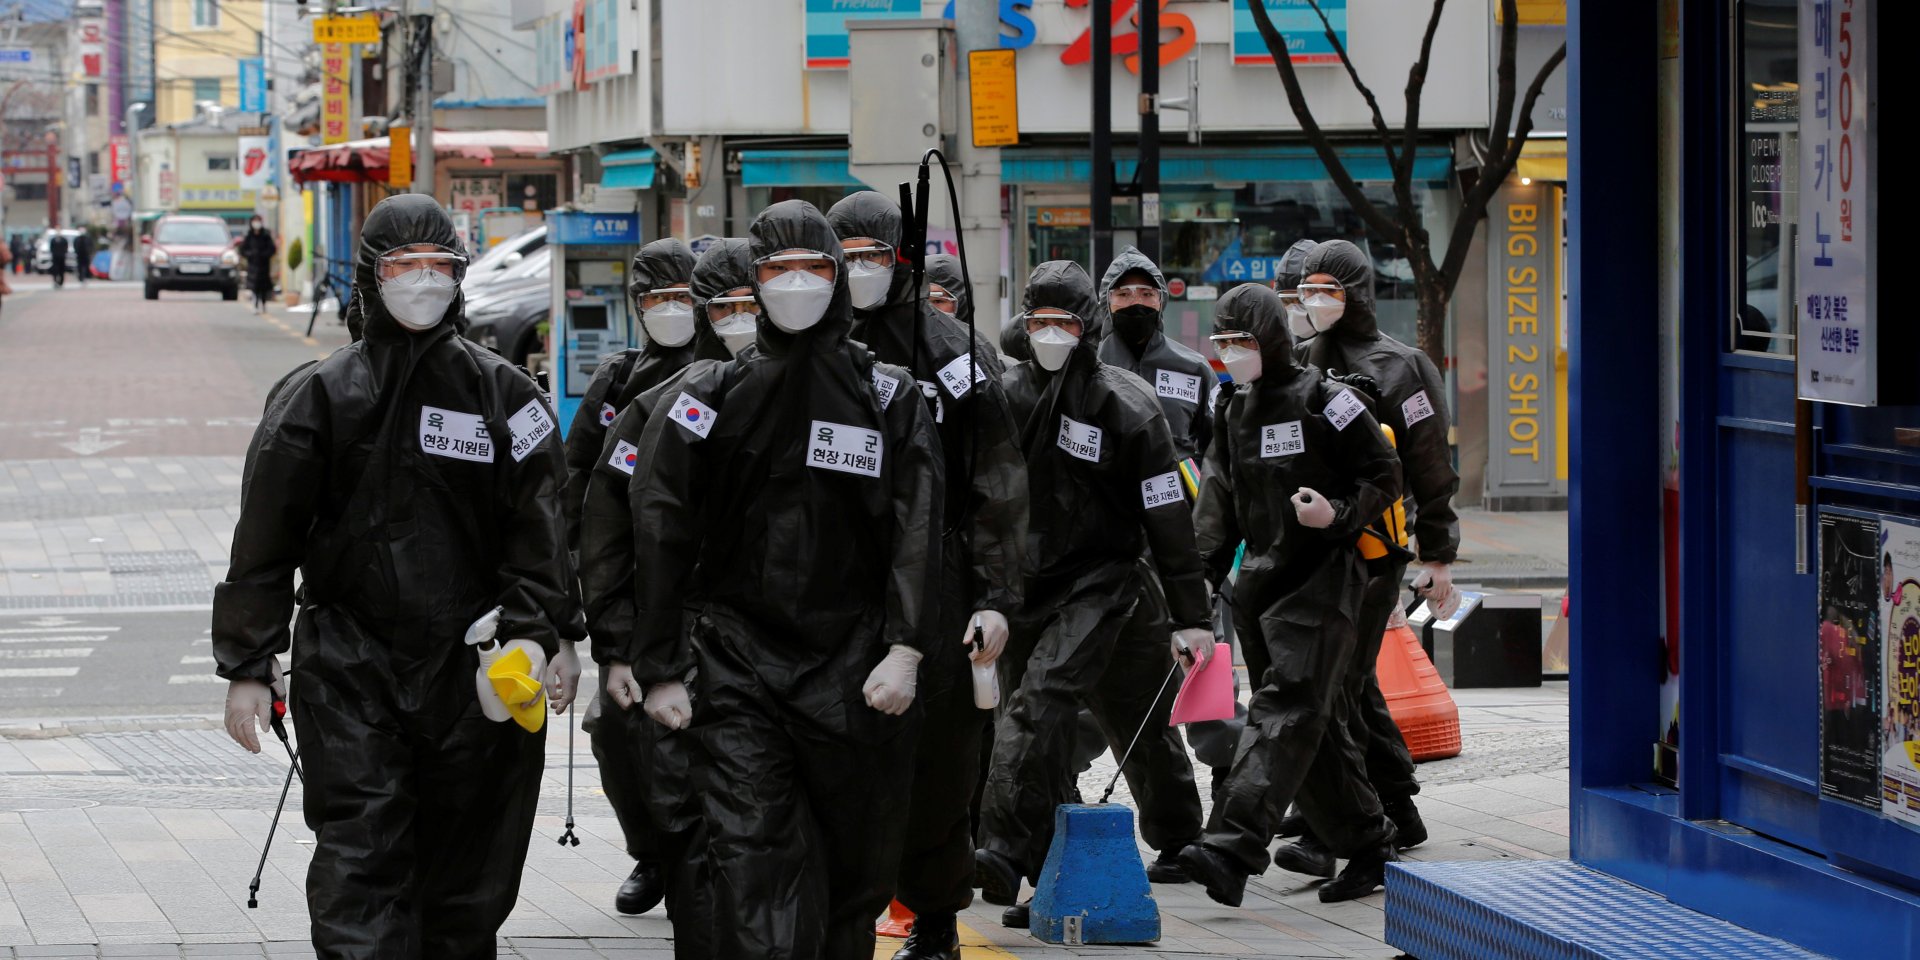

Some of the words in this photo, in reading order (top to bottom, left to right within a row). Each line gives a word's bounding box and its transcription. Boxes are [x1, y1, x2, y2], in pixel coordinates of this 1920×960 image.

[594, 219, 629, 233] ATM
[1507, 203, 1537, 257] BIG
[1507, 266, 1538, 336] SIZE
[1507, 344, 1538, 363] 2
[1159, 385, 1174, 395] 현장
[1176, 388, 1196, 400] 지원팀
[427, 412, 444, 432] 육
[1508, 372, 1540, 463] SHOT
[529, 420, 551, 444] 지원팀
[817, 427, 834, 446] 육
[864, 434, 878, 454] 군
[423, 433, 449, 451] 현장
[451, 439, 490, 457] 지원팀
[1071, 441, 1098, 458] 지원팀
[1265, 443, 1281, 454] 현장
[1282, 439, 1302, 452] 지원팀
[813, 447, 840, 465] 현장
[841, 452, 877, 472] 지원팀
[1146, 493, 1160, 505] 현장
[1161, 488, 1181, 502] 지원팀
